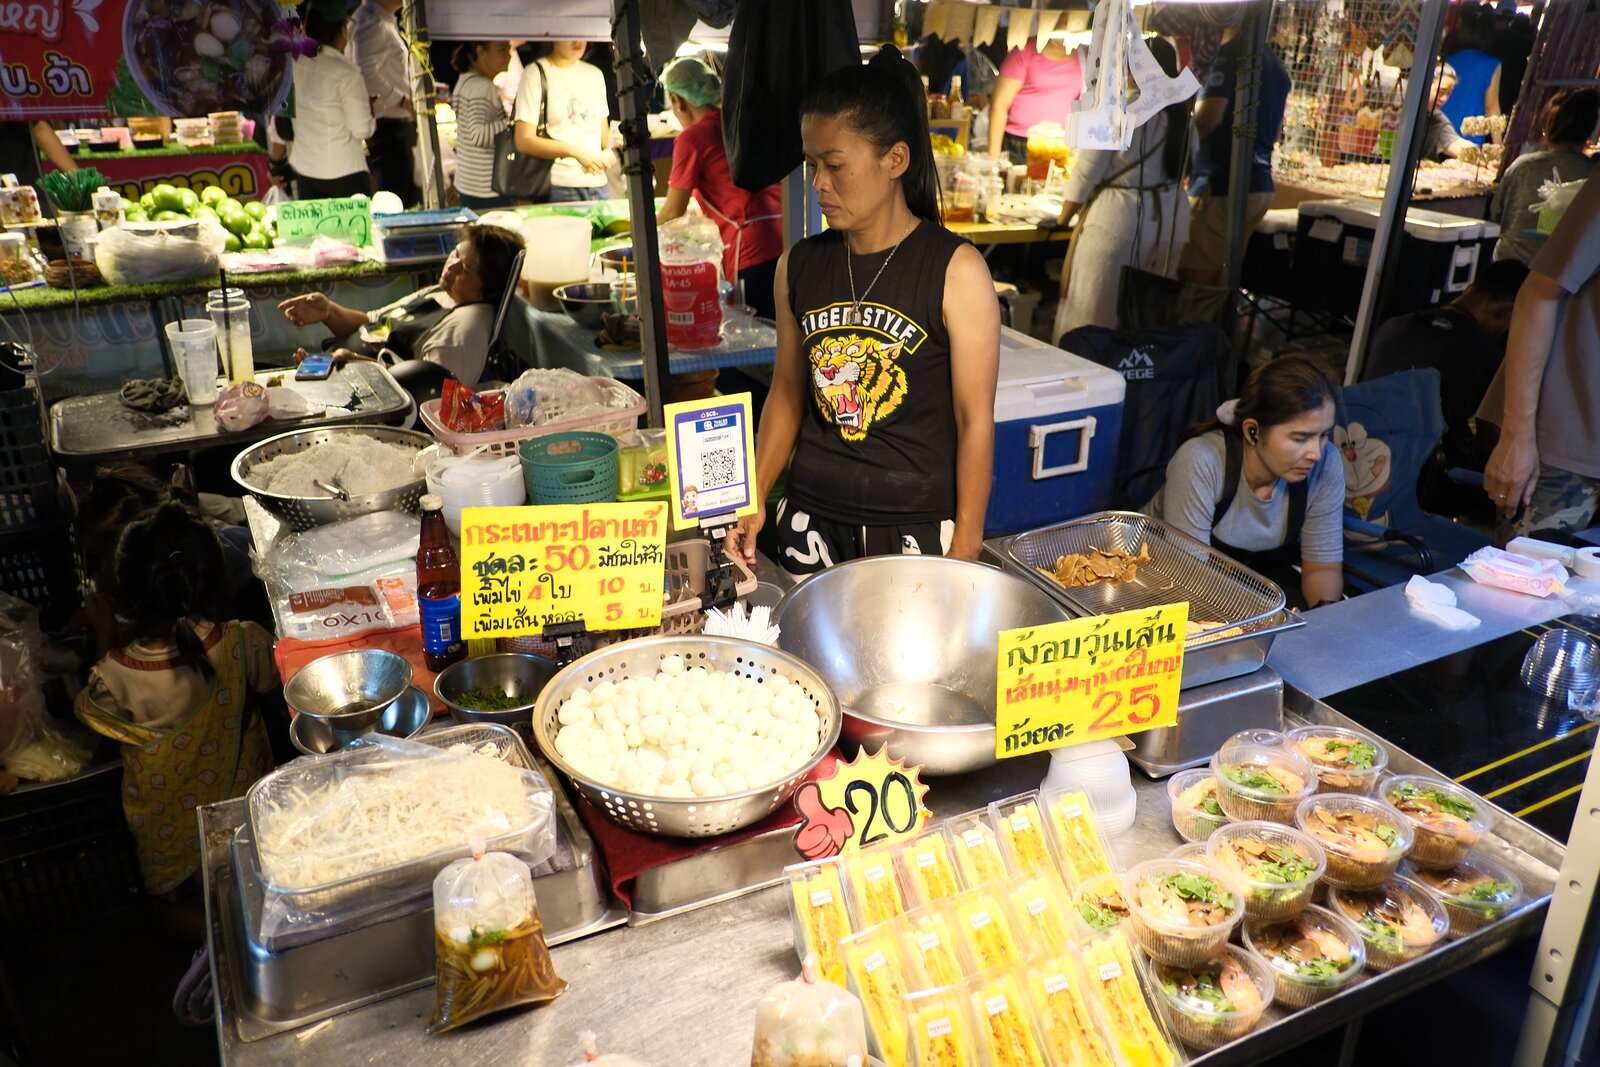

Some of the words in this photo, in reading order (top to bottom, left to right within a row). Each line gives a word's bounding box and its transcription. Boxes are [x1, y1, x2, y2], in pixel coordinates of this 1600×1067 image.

[862, 307, 917, 343] STYLE
[527, 584, 544, 601] 4
[537, 572, 572, 599] ใบ
[597, 576, 625, 596] 10
[605, 602, 623, 621] 5
[1088, 683, 1161, 732] 25
[844, 771, 917, 849] 20
